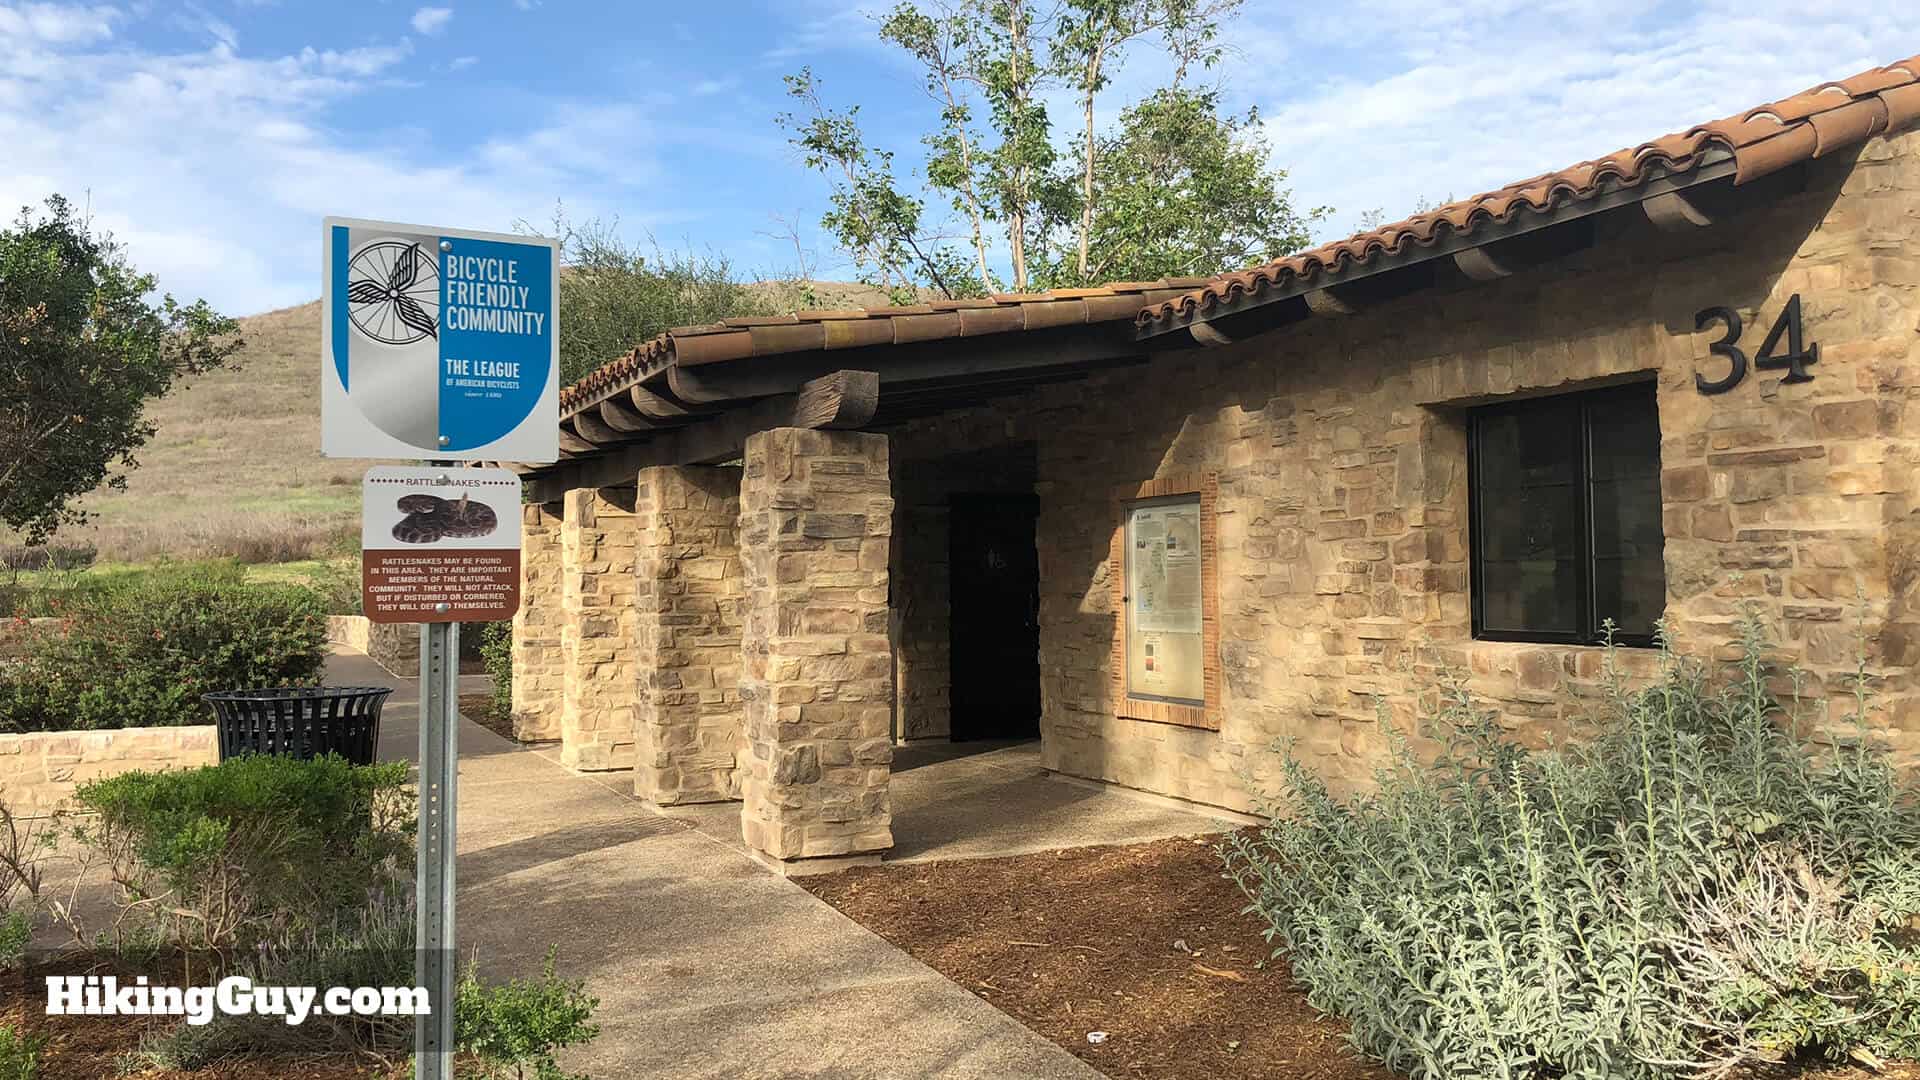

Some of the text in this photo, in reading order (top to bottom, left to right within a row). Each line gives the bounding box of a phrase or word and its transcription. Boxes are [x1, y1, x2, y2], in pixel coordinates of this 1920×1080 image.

[447, 254, 518, 284] BICYCLE
[447, 280, 529, 310] FRIENDLY
[446, 305, 545, 336] COMMUNITY
[1695, 293, 1818, 396] 34
[446, 359, 520, 378] THE LEAGUE
[446, 378, 520, 389] OF AMERICAN BICYCLISTS
[406, 478, 481, 488] RATTLENAKES
[429, 566, 449, 574] THEY
[377, 603, 398, 611] THEY
[420, 602, 452, 610] DEFD
